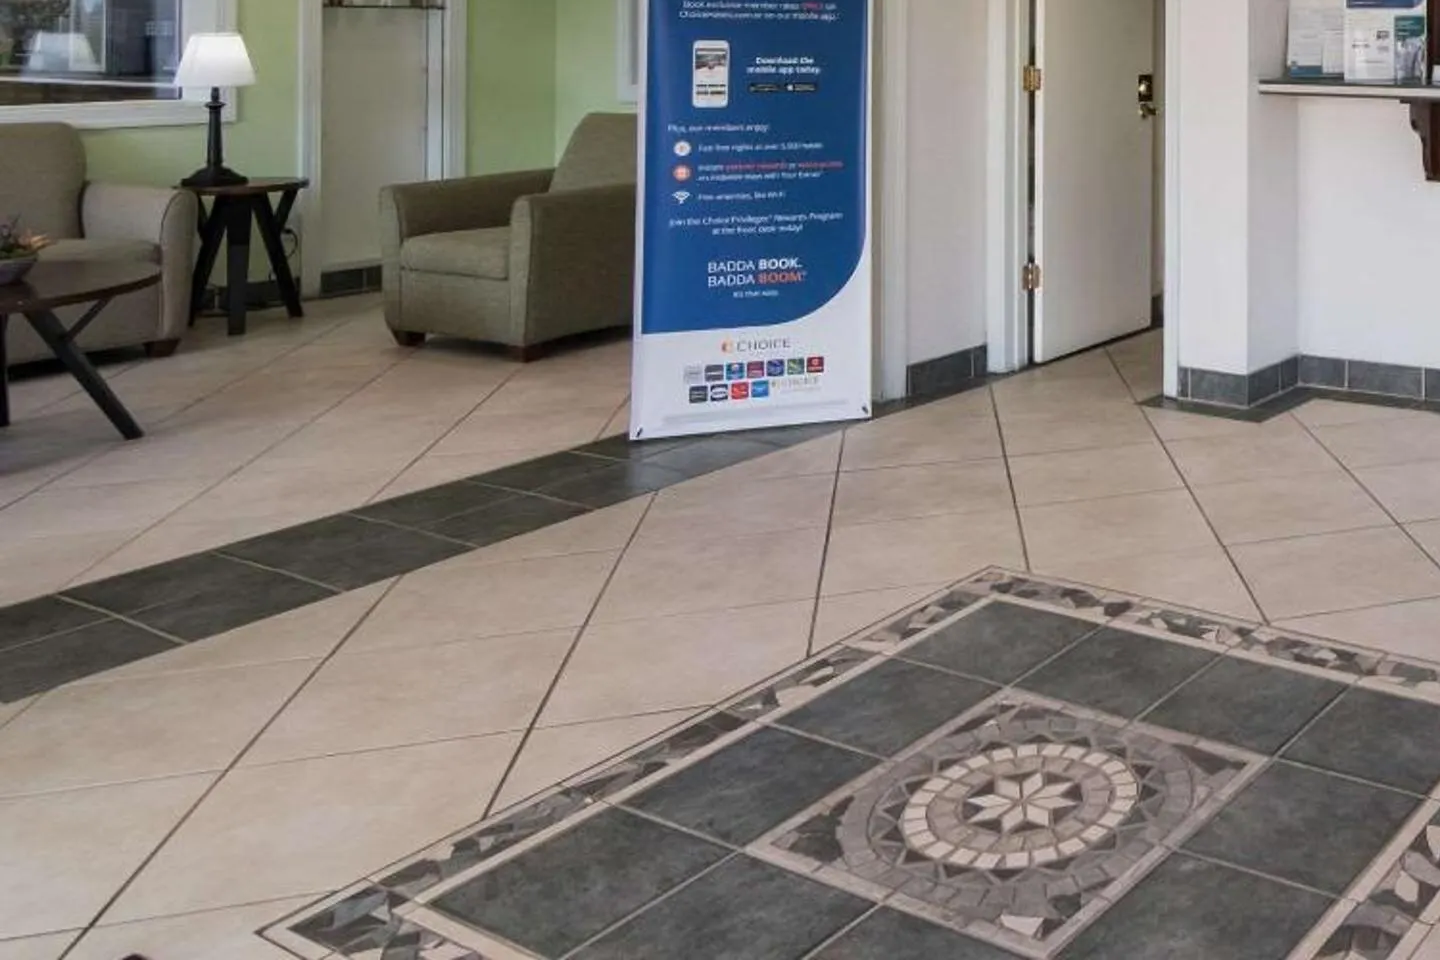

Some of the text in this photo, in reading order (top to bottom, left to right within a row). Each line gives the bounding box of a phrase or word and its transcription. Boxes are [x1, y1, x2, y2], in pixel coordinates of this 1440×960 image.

[708, 257, 802, 274] BADDA BOOK.
[708, 274, 755, 288] BADDA
[737, 339, 791, 352] CHOICE
